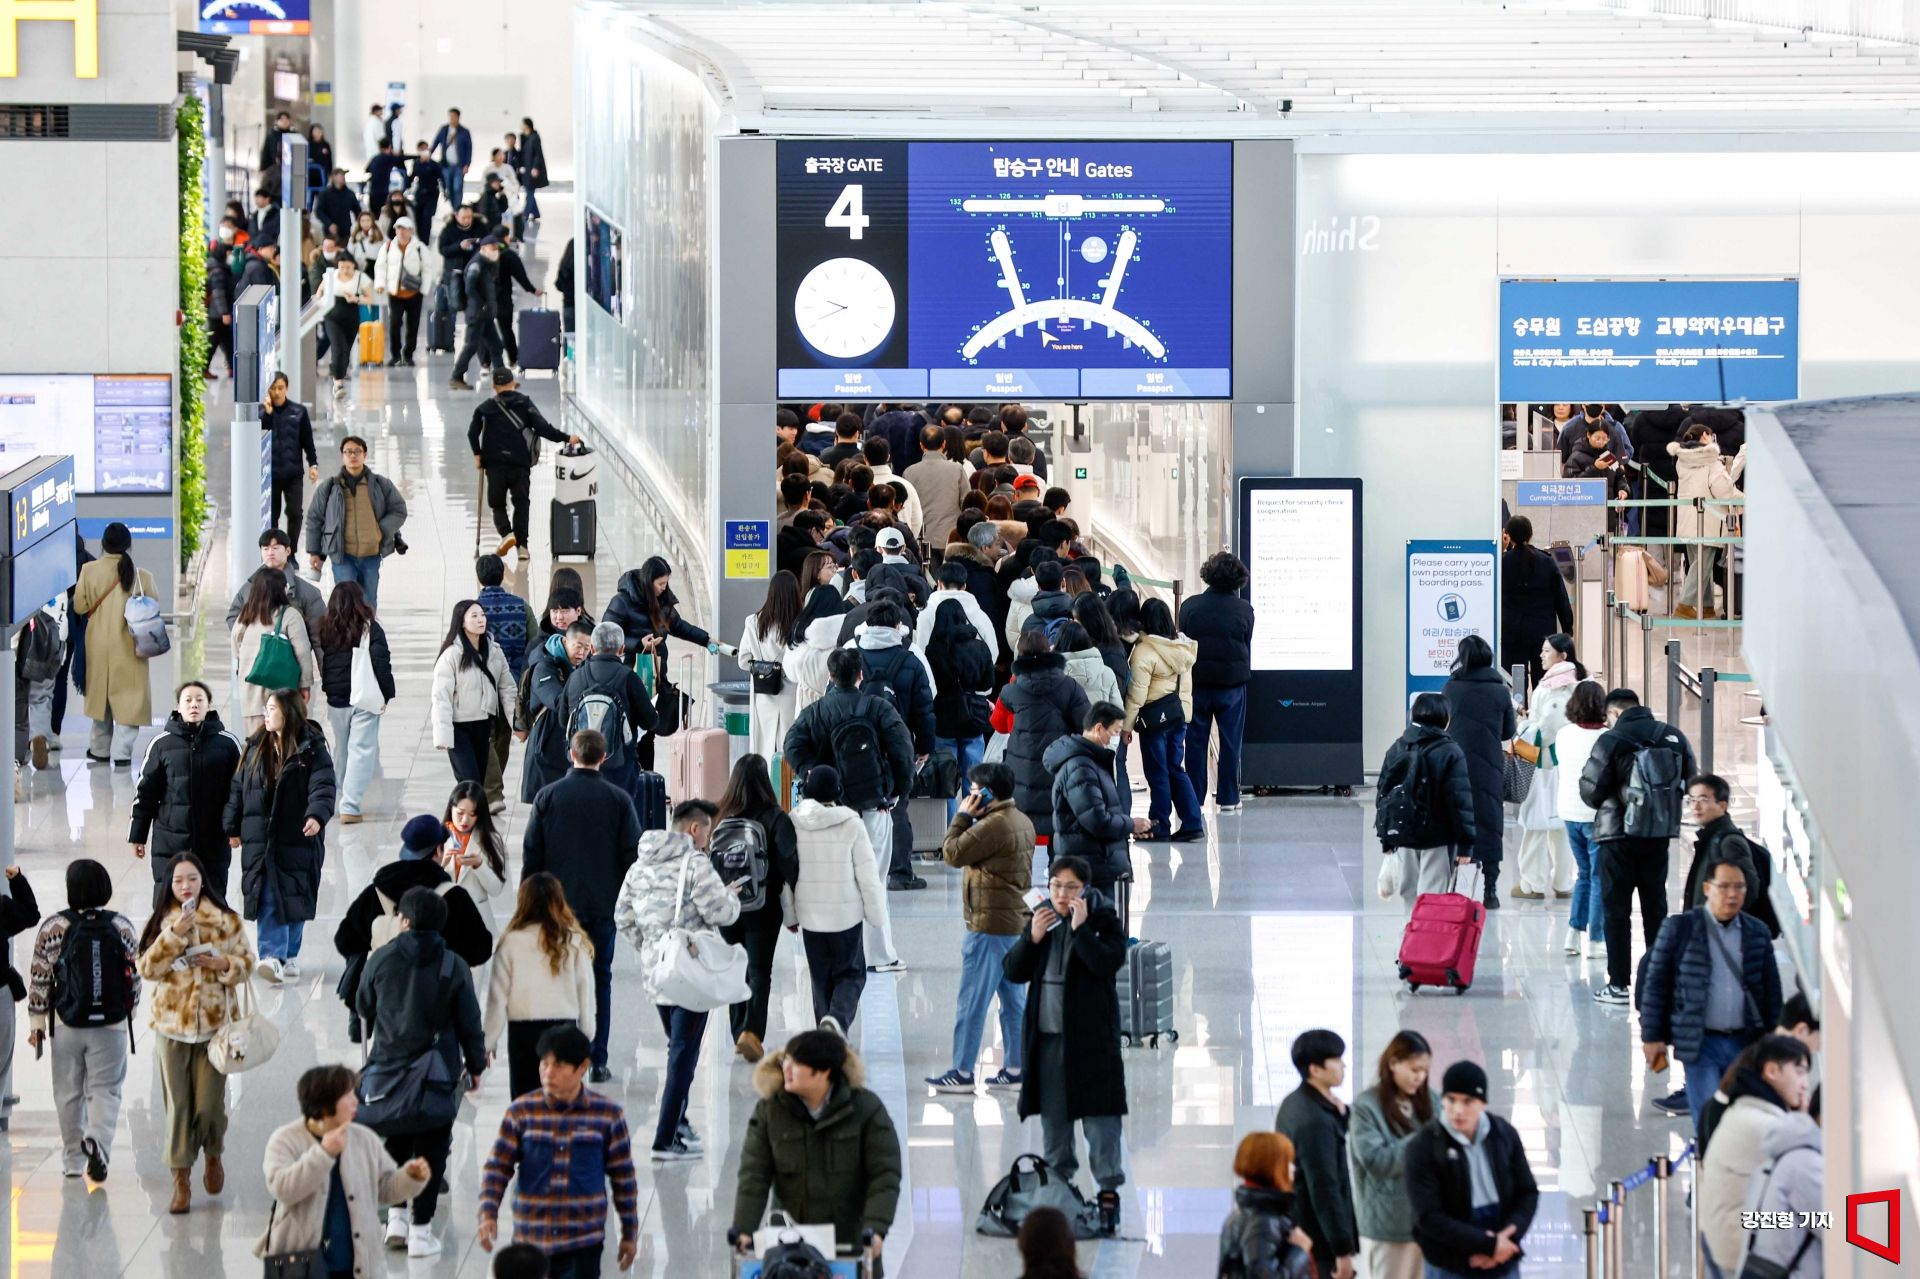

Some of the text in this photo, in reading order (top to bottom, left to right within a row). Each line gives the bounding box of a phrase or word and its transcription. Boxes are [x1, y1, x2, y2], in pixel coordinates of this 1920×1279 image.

[805, 157, 883, 174] 출국장 GATE
[993, 157, 1133, 178] 탑승구 안내 Gates
[825, 184, 870, 240] 4
[1513, 316, 1785, 337] 승무원 도심공항 교통약자우대출구
[1539, 359, 1552, 368] City
[1553, 358, 1577, 368] Airport
[1578, 358, 1606, 366] Terminal
[1607, 358, 1640, 368] Passenger
[1656, 358, 1698, 367] Priority Lane
[834, 384, 872, 395] Passport
[986, 384, 1023, 395] Passport
[1136, 384, 1173, 395] Passport
[1529, 494, 1557, 502] Currency
[1413, 558, 1491, 568] Please carry your
[1432, 569, 1472, 578] passport
[1474, 569, 1492, 577] and
[1419, 579, 1459, 588] boarding
[1437, 639, 1460, 648] 반드
[1428, 649, 1454, 658] 본인이
